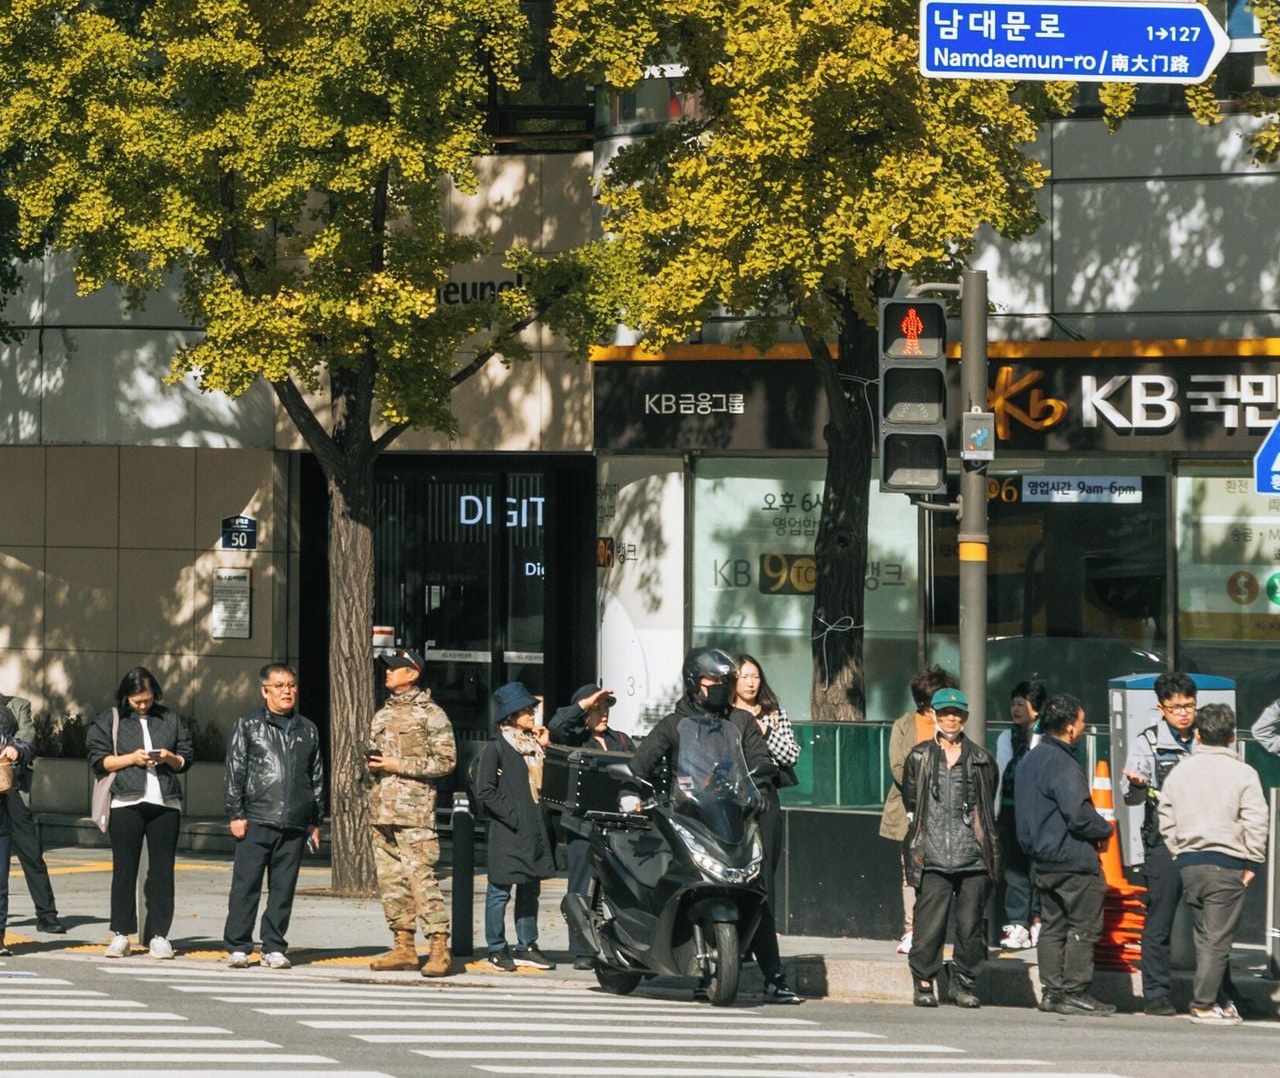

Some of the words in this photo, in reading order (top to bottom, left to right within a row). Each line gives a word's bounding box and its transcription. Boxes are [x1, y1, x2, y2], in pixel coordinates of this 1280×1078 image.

[934, 9, 1065, 40] 남대문로
[645, 392, 745, 415] KB금융그룹
[1027, 480, 1072, 496] 영업시간
[1077, 480, 1137, 497] 9am-6pm
[1225, 478, 1249, 494] 환전
[762, 492, 796, 513] 오후
[231, 532, 247, 547] 50
[1231, 527, 1253, 542] 송금
[714, 558, 752, 588] KB
[627, 677, 635, 696] 3
